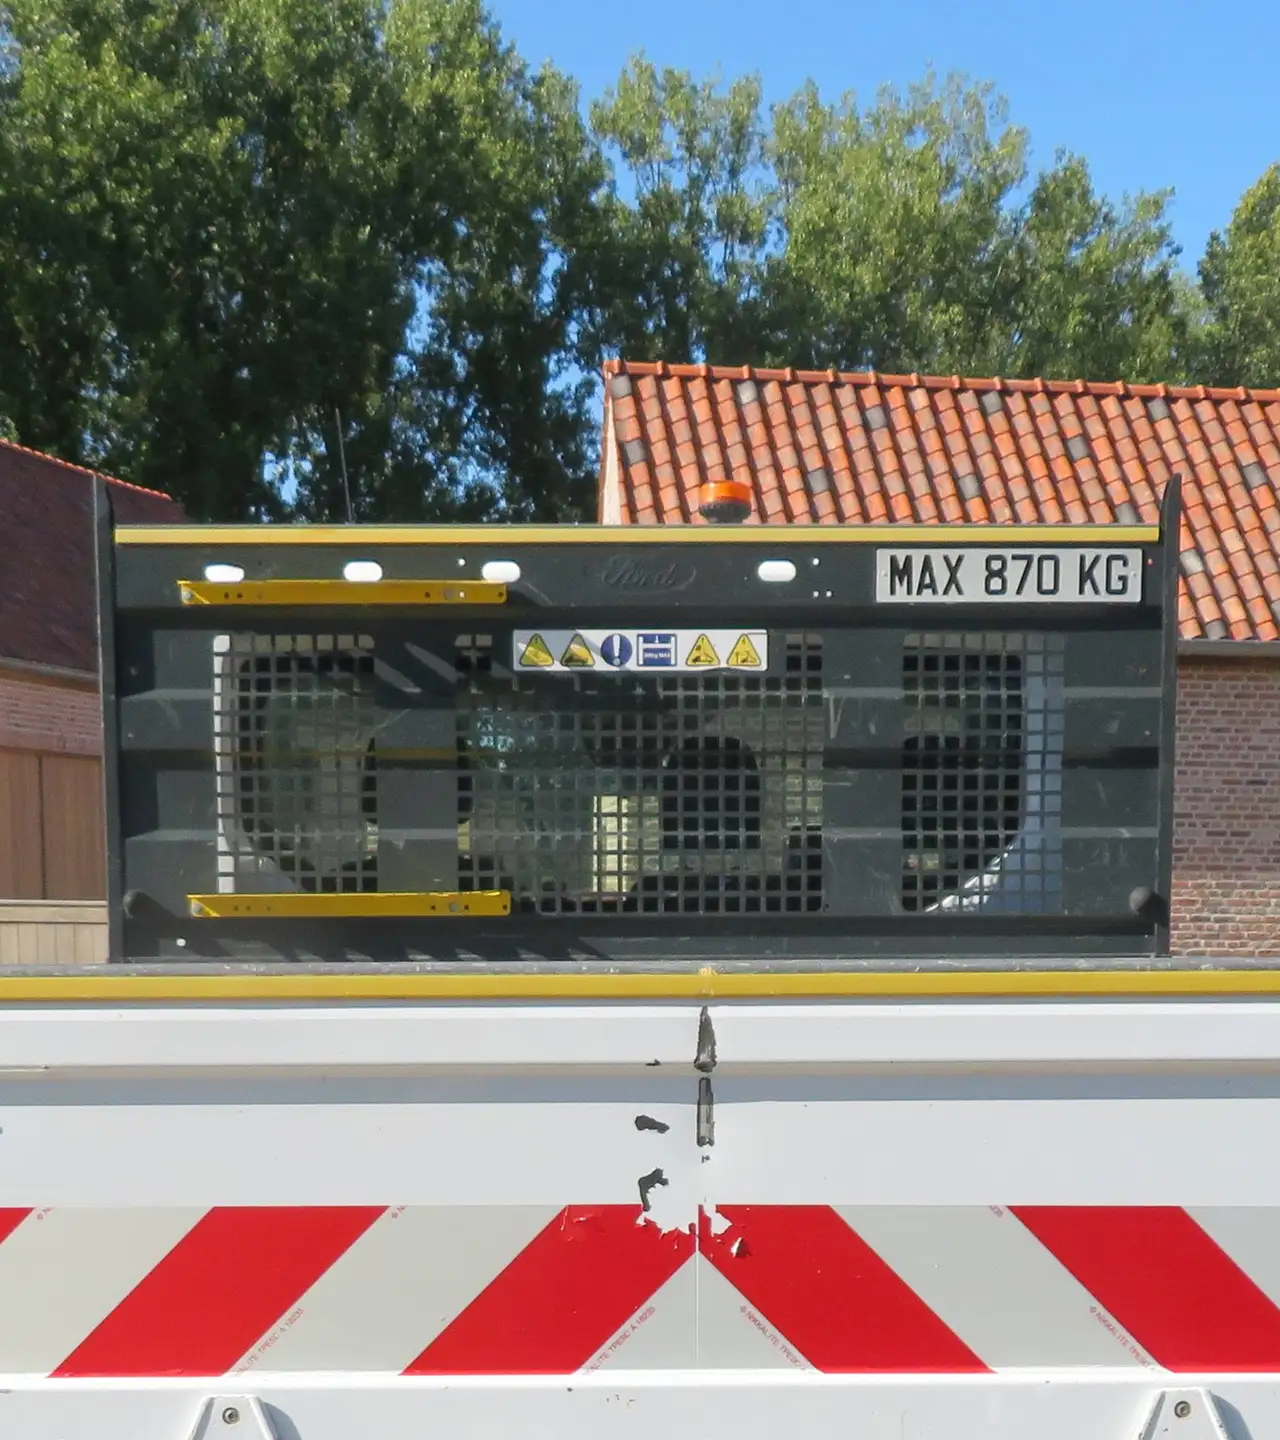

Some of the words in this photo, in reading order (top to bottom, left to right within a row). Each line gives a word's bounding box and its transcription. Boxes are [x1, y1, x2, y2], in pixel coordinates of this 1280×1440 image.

[604, 555, 677, 586] Ford
[889, 554, 964, 596] MAX
[984, 554, 1060, 595] 870
[1078, 554, 1129, 595] KG
